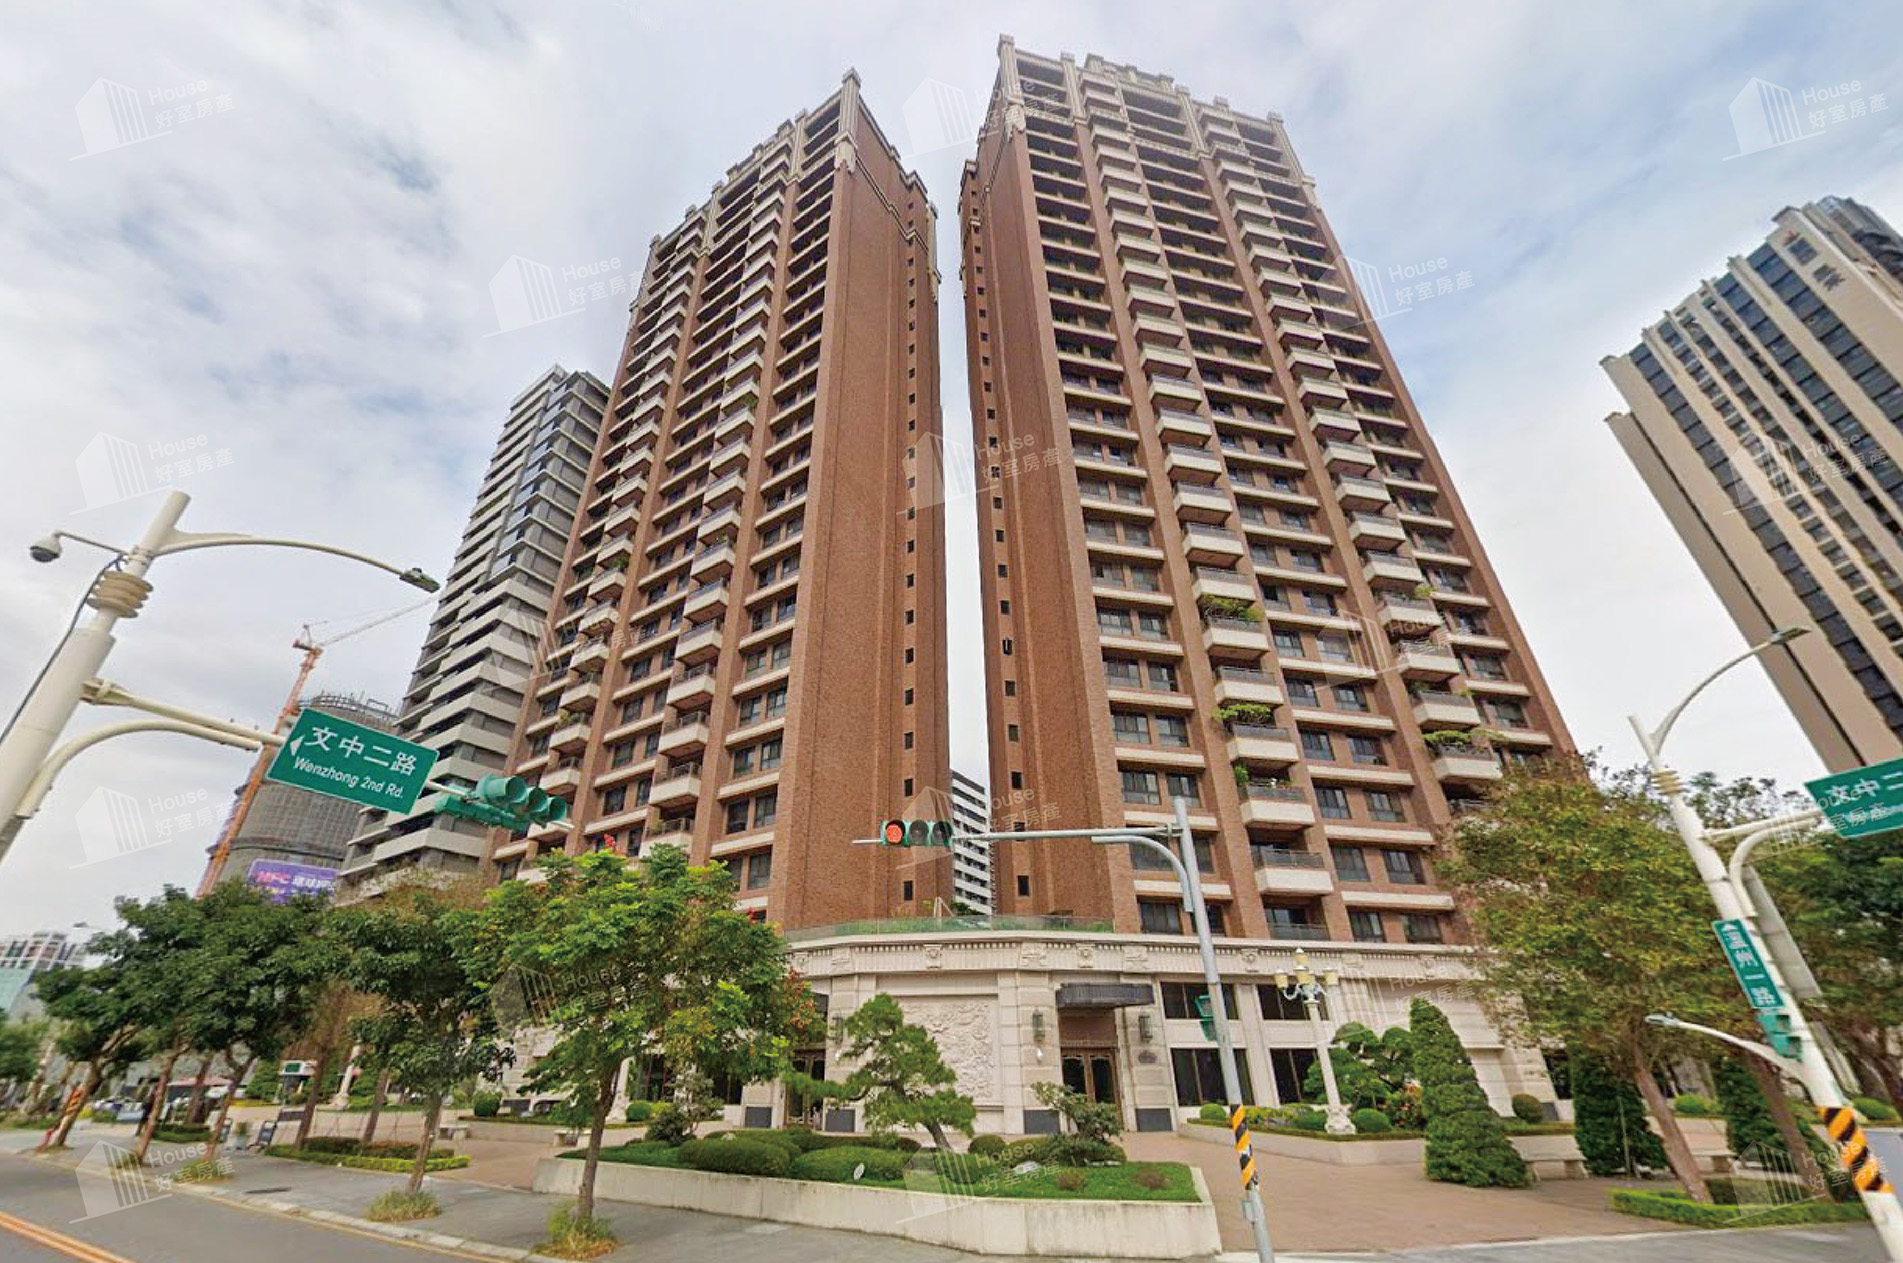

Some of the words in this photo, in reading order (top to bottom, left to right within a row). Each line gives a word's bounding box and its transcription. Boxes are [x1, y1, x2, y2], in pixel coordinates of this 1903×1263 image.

[304, 727, 417, 776] 文中二路
[294, 756, 359, 788] Wenzhong
[360, 776, 385, 793] 2nd
[385, 782, 404, 799] Rd.
